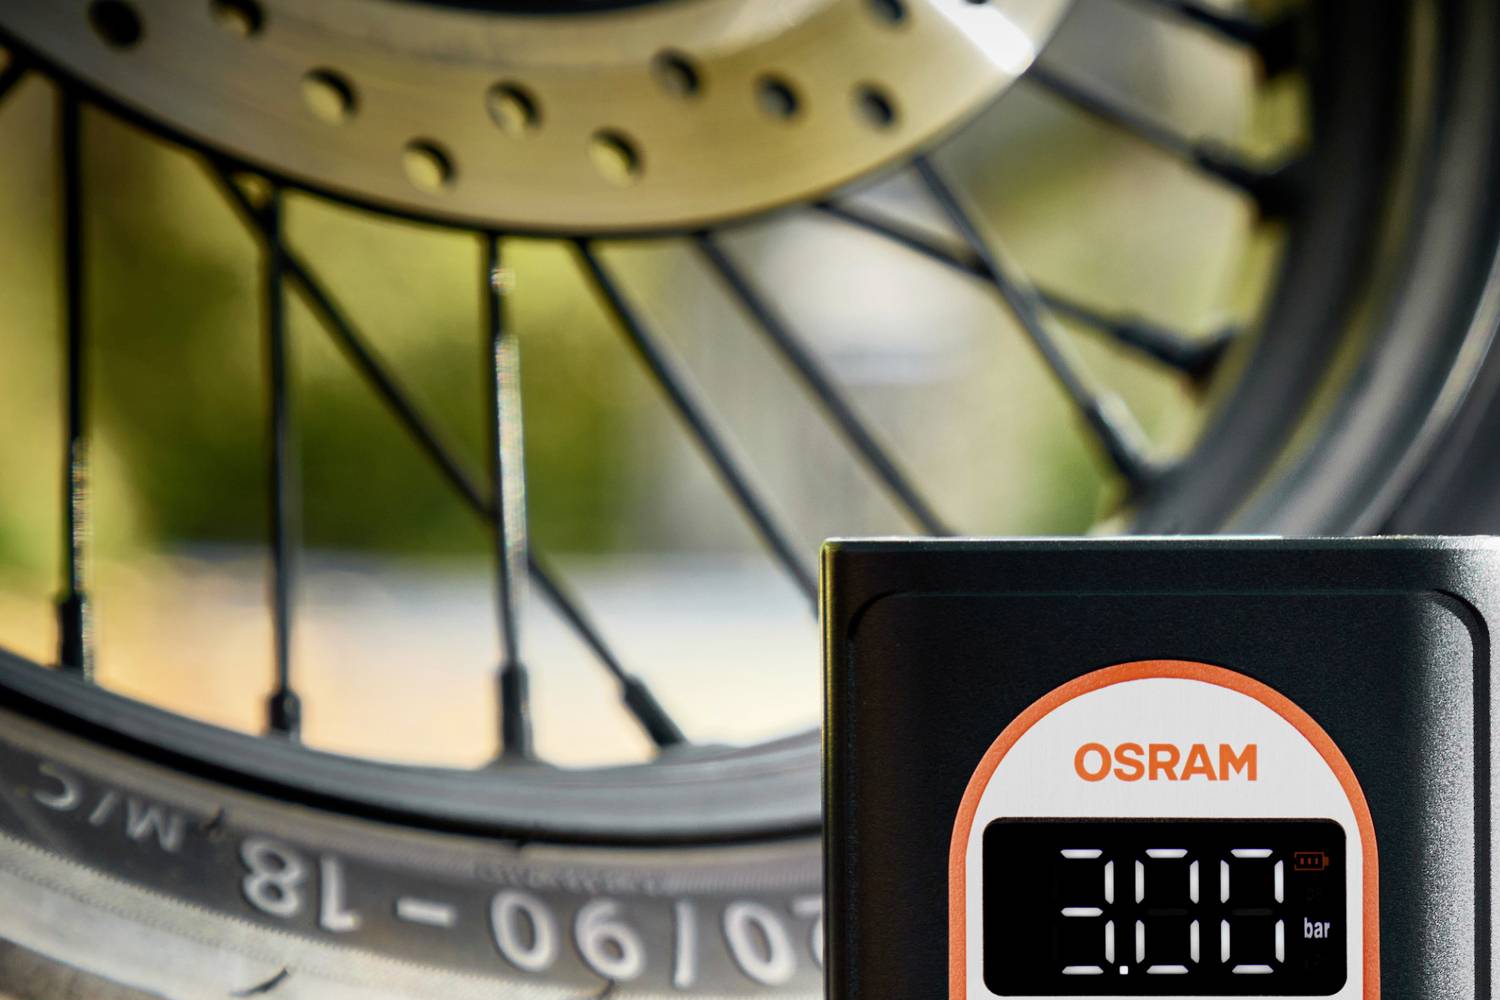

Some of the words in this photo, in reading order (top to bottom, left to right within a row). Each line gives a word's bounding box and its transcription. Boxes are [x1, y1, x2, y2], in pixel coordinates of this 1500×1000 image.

[1074, 743, 1258, 782] OSRAM
[241, 838, 360, 933] 18
[1060, 848, 1285, 975] 3.00
[1303, 916, 1331, 939] bar
